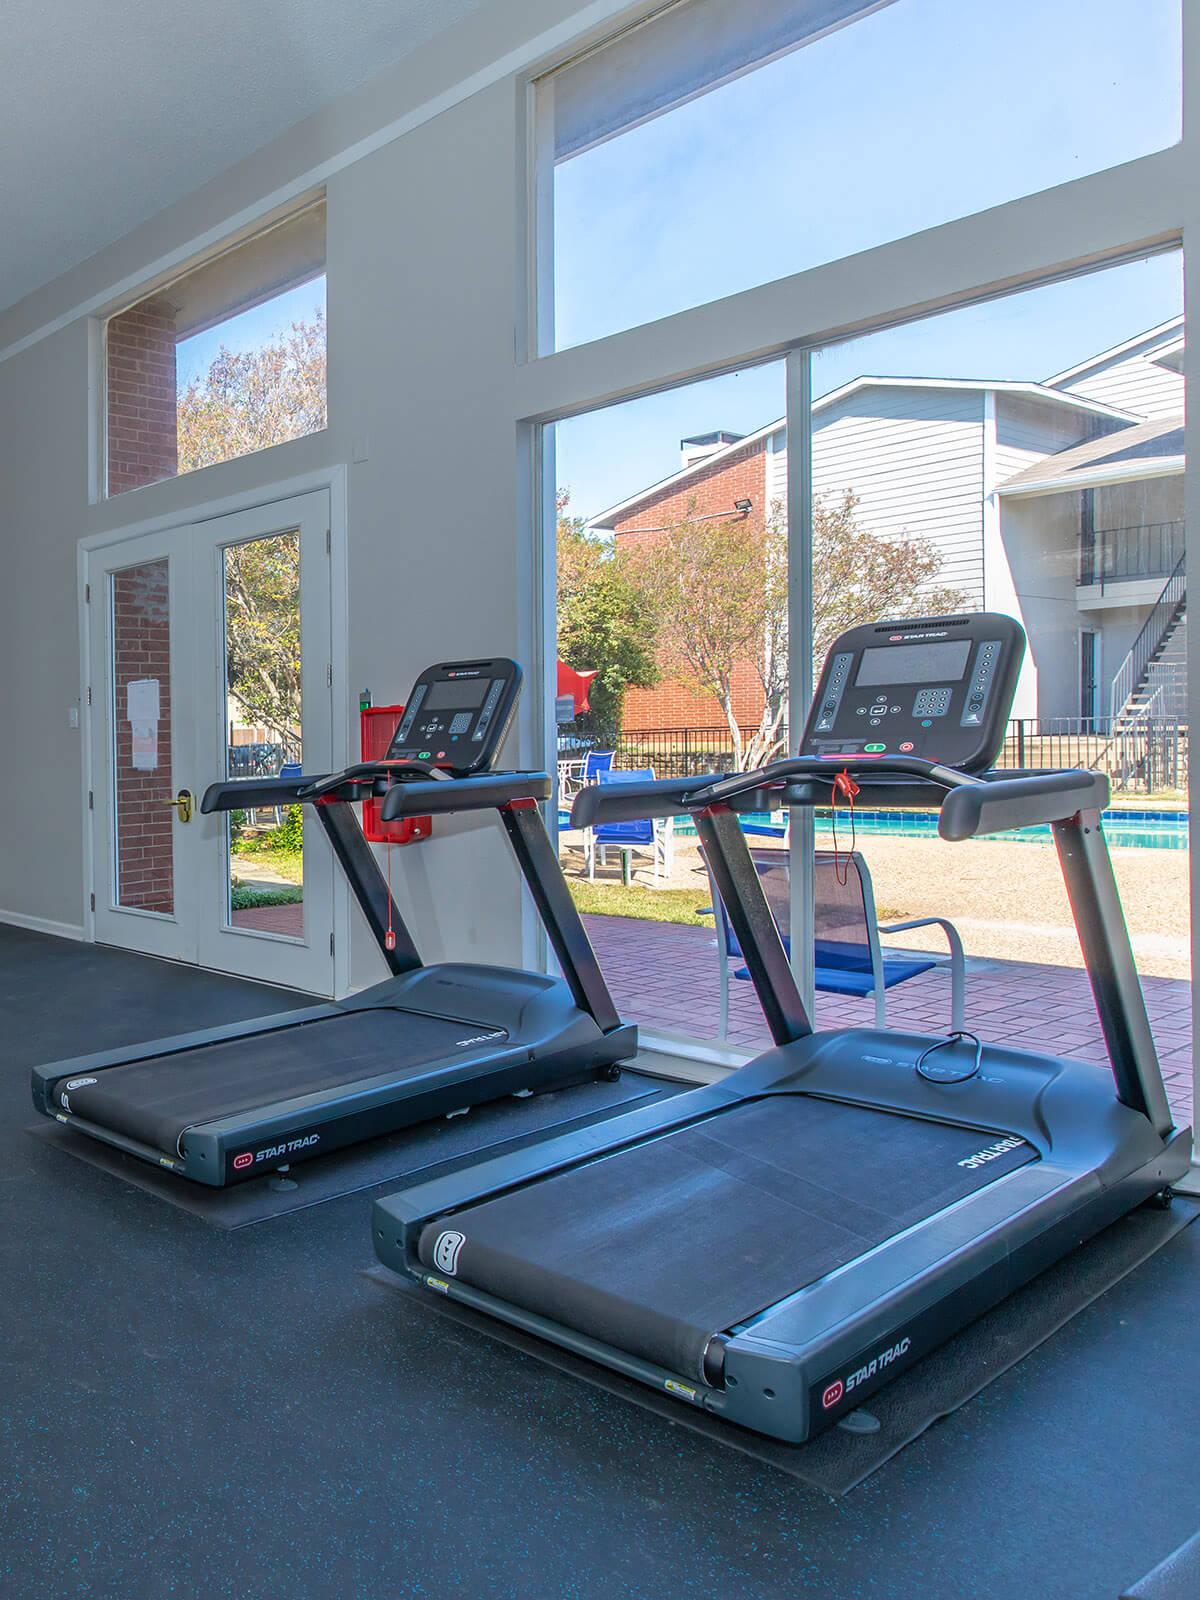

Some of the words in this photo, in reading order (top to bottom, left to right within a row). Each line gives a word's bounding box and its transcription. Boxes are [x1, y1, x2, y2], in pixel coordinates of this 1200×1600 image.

[255, 1143, 286, 1162] STAR
[287, 1133, 319, 1152] TRAC
[845, 1359, 878, 1393] STAR
[878, 1337, 910, 1370] TRAC
